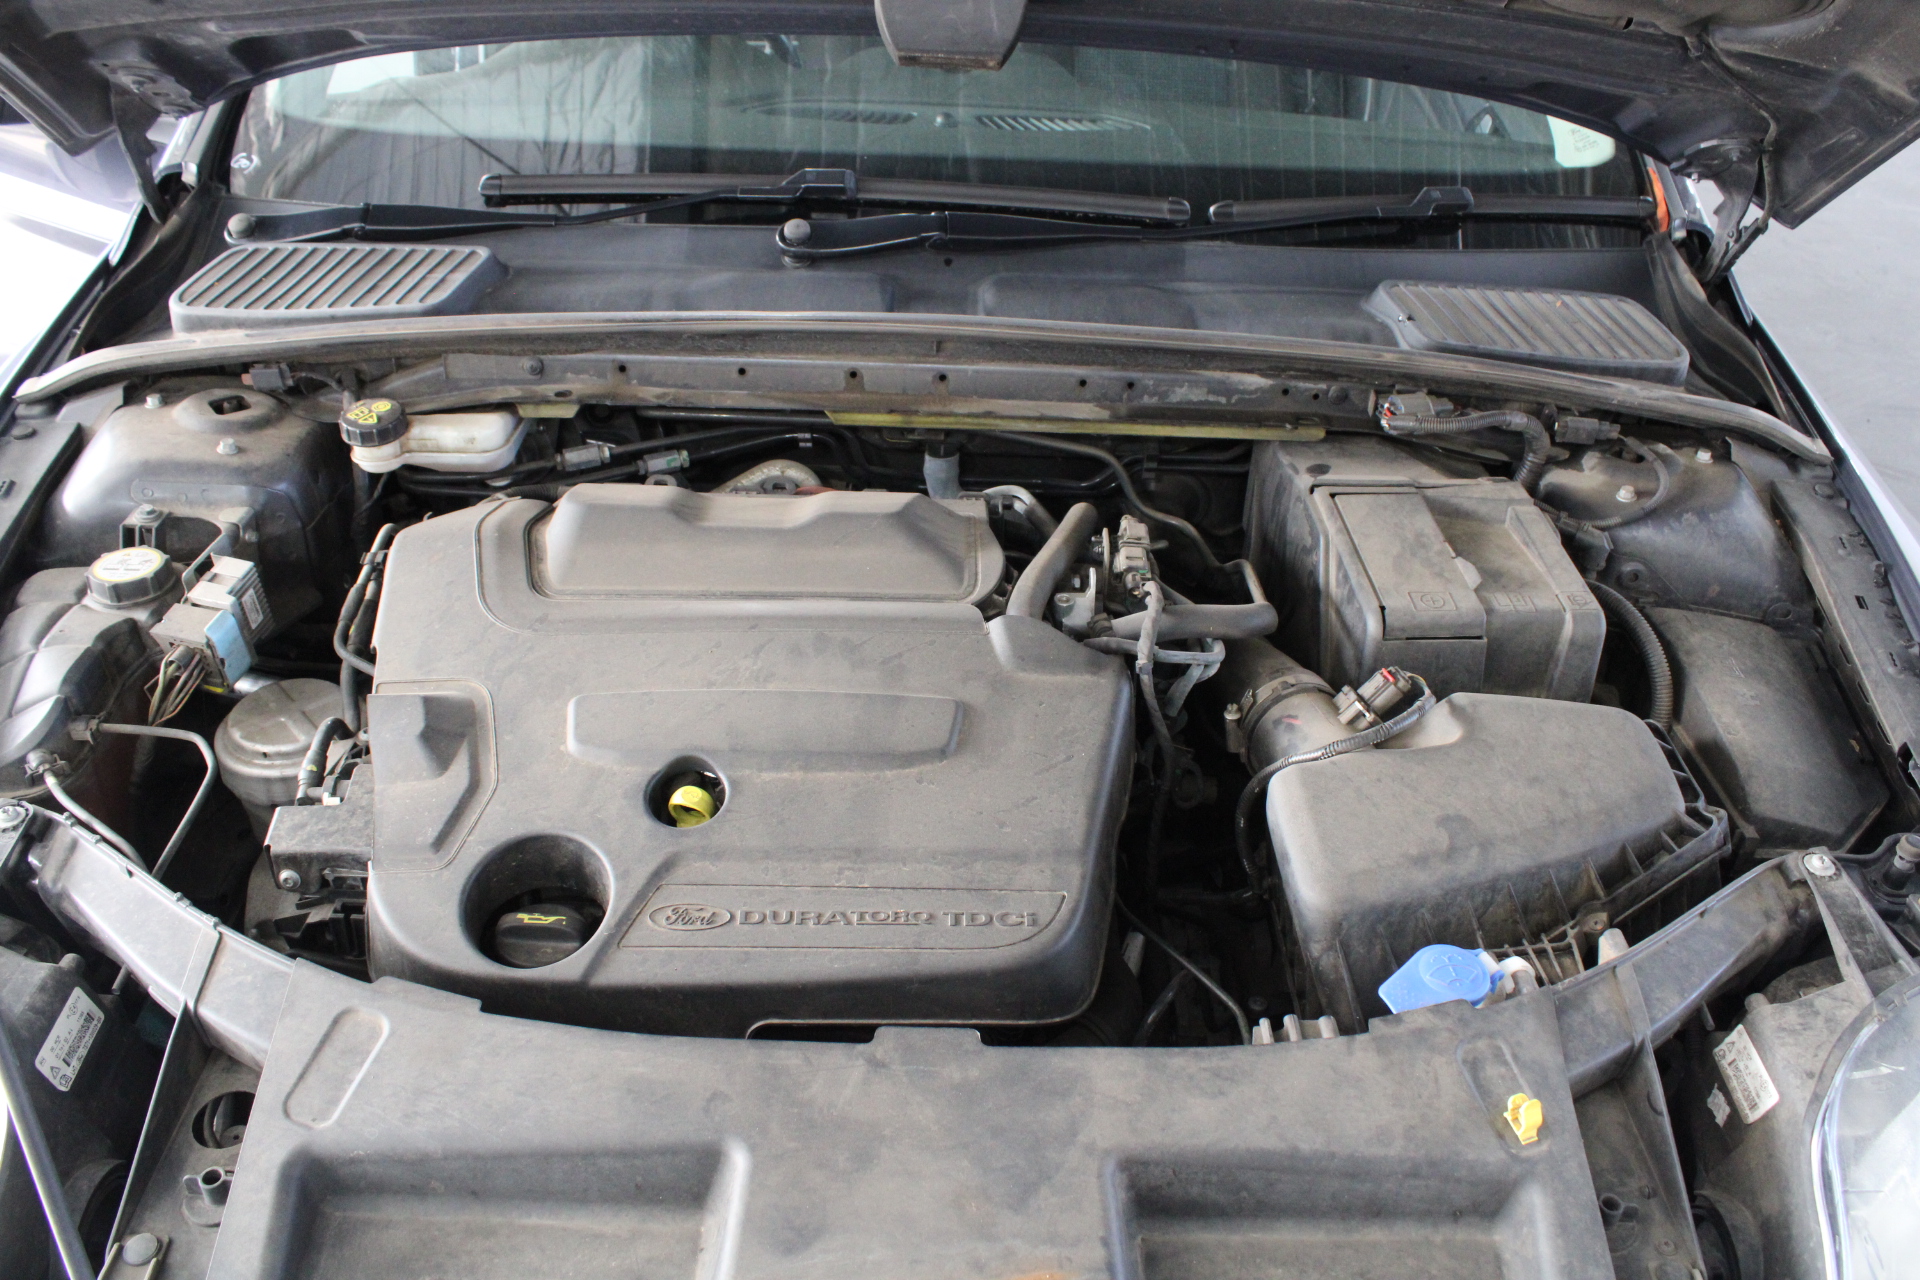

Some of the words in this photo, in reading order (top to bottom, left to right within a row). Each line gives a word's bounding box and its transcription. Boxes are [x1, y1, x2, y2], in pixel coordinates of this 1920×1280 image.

[664, 906, 717, 926] Ford
[738, 909, 932, 926] DURATORQ
[942, 911, 1037, 927] TDCi
